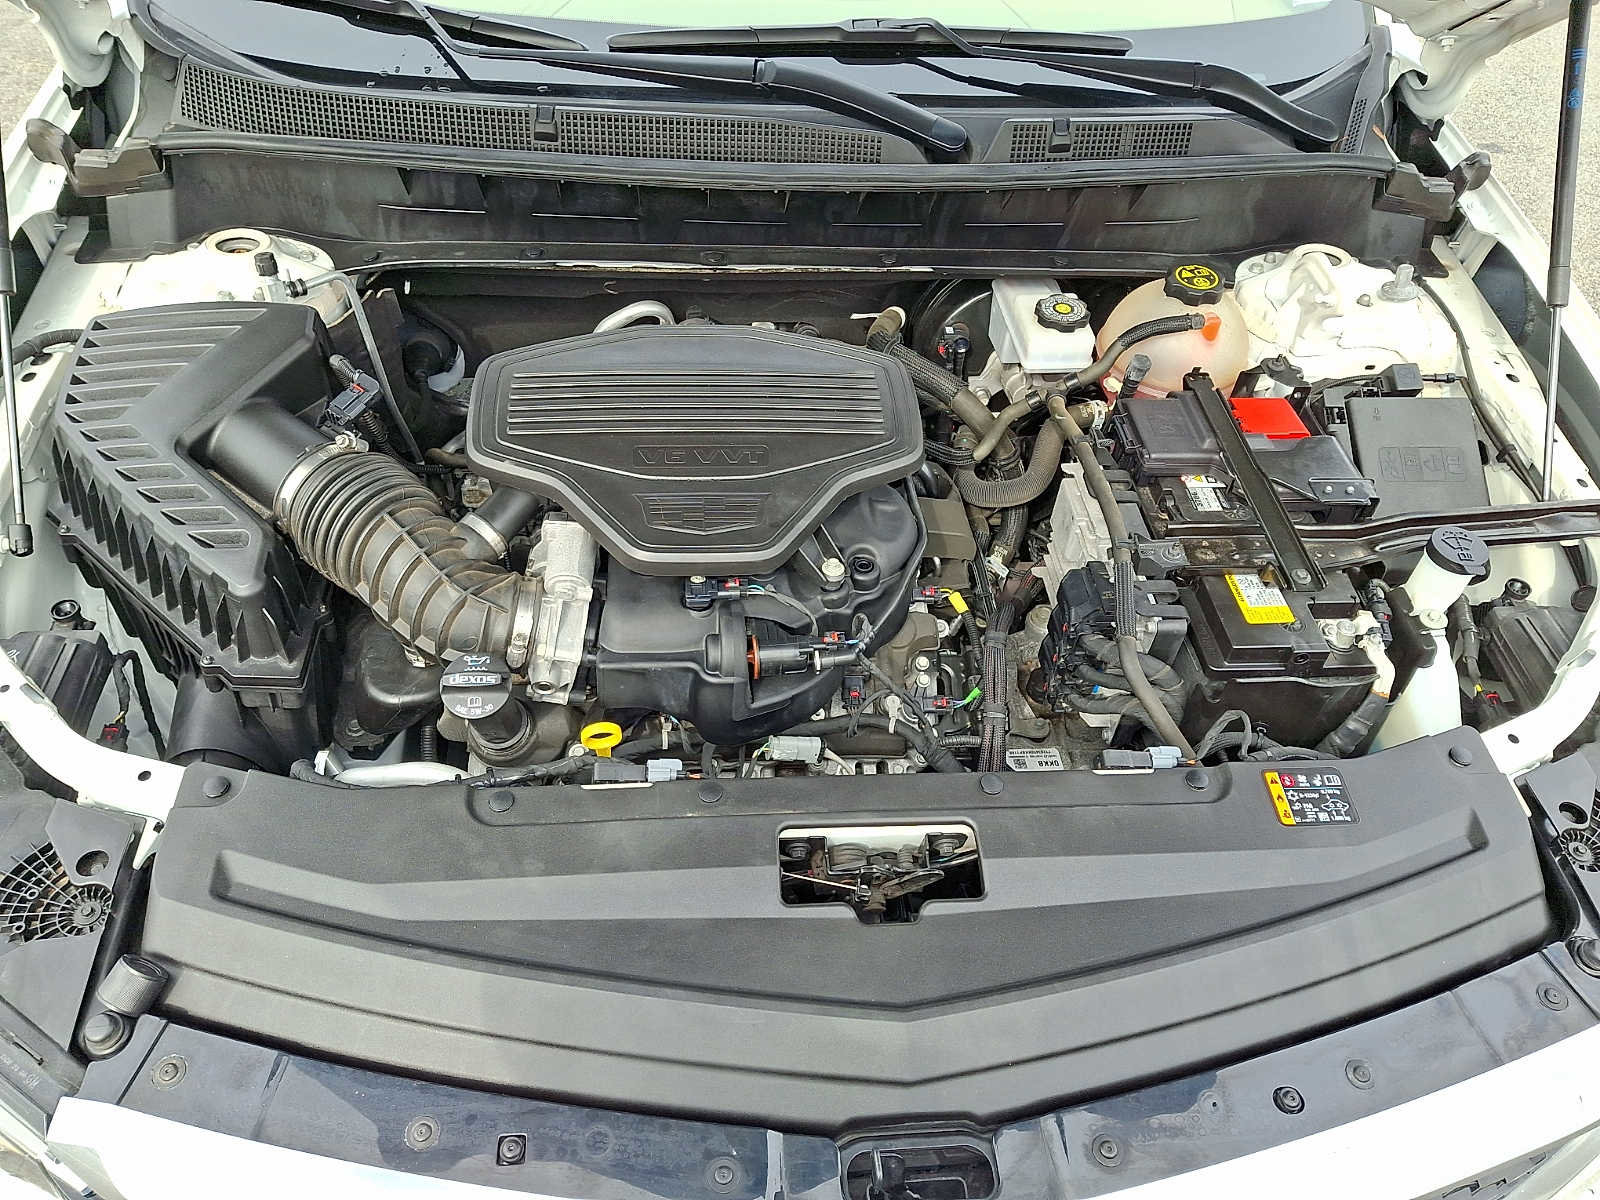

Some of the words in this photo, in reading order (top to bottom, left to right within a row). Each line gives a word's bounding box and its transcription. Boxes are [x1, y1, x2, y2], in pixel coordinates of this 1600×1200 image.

[638, 449, 687, 464] V6
[693, 449, 764, 464] VVT
[450, 674, 497, 684] dexos
